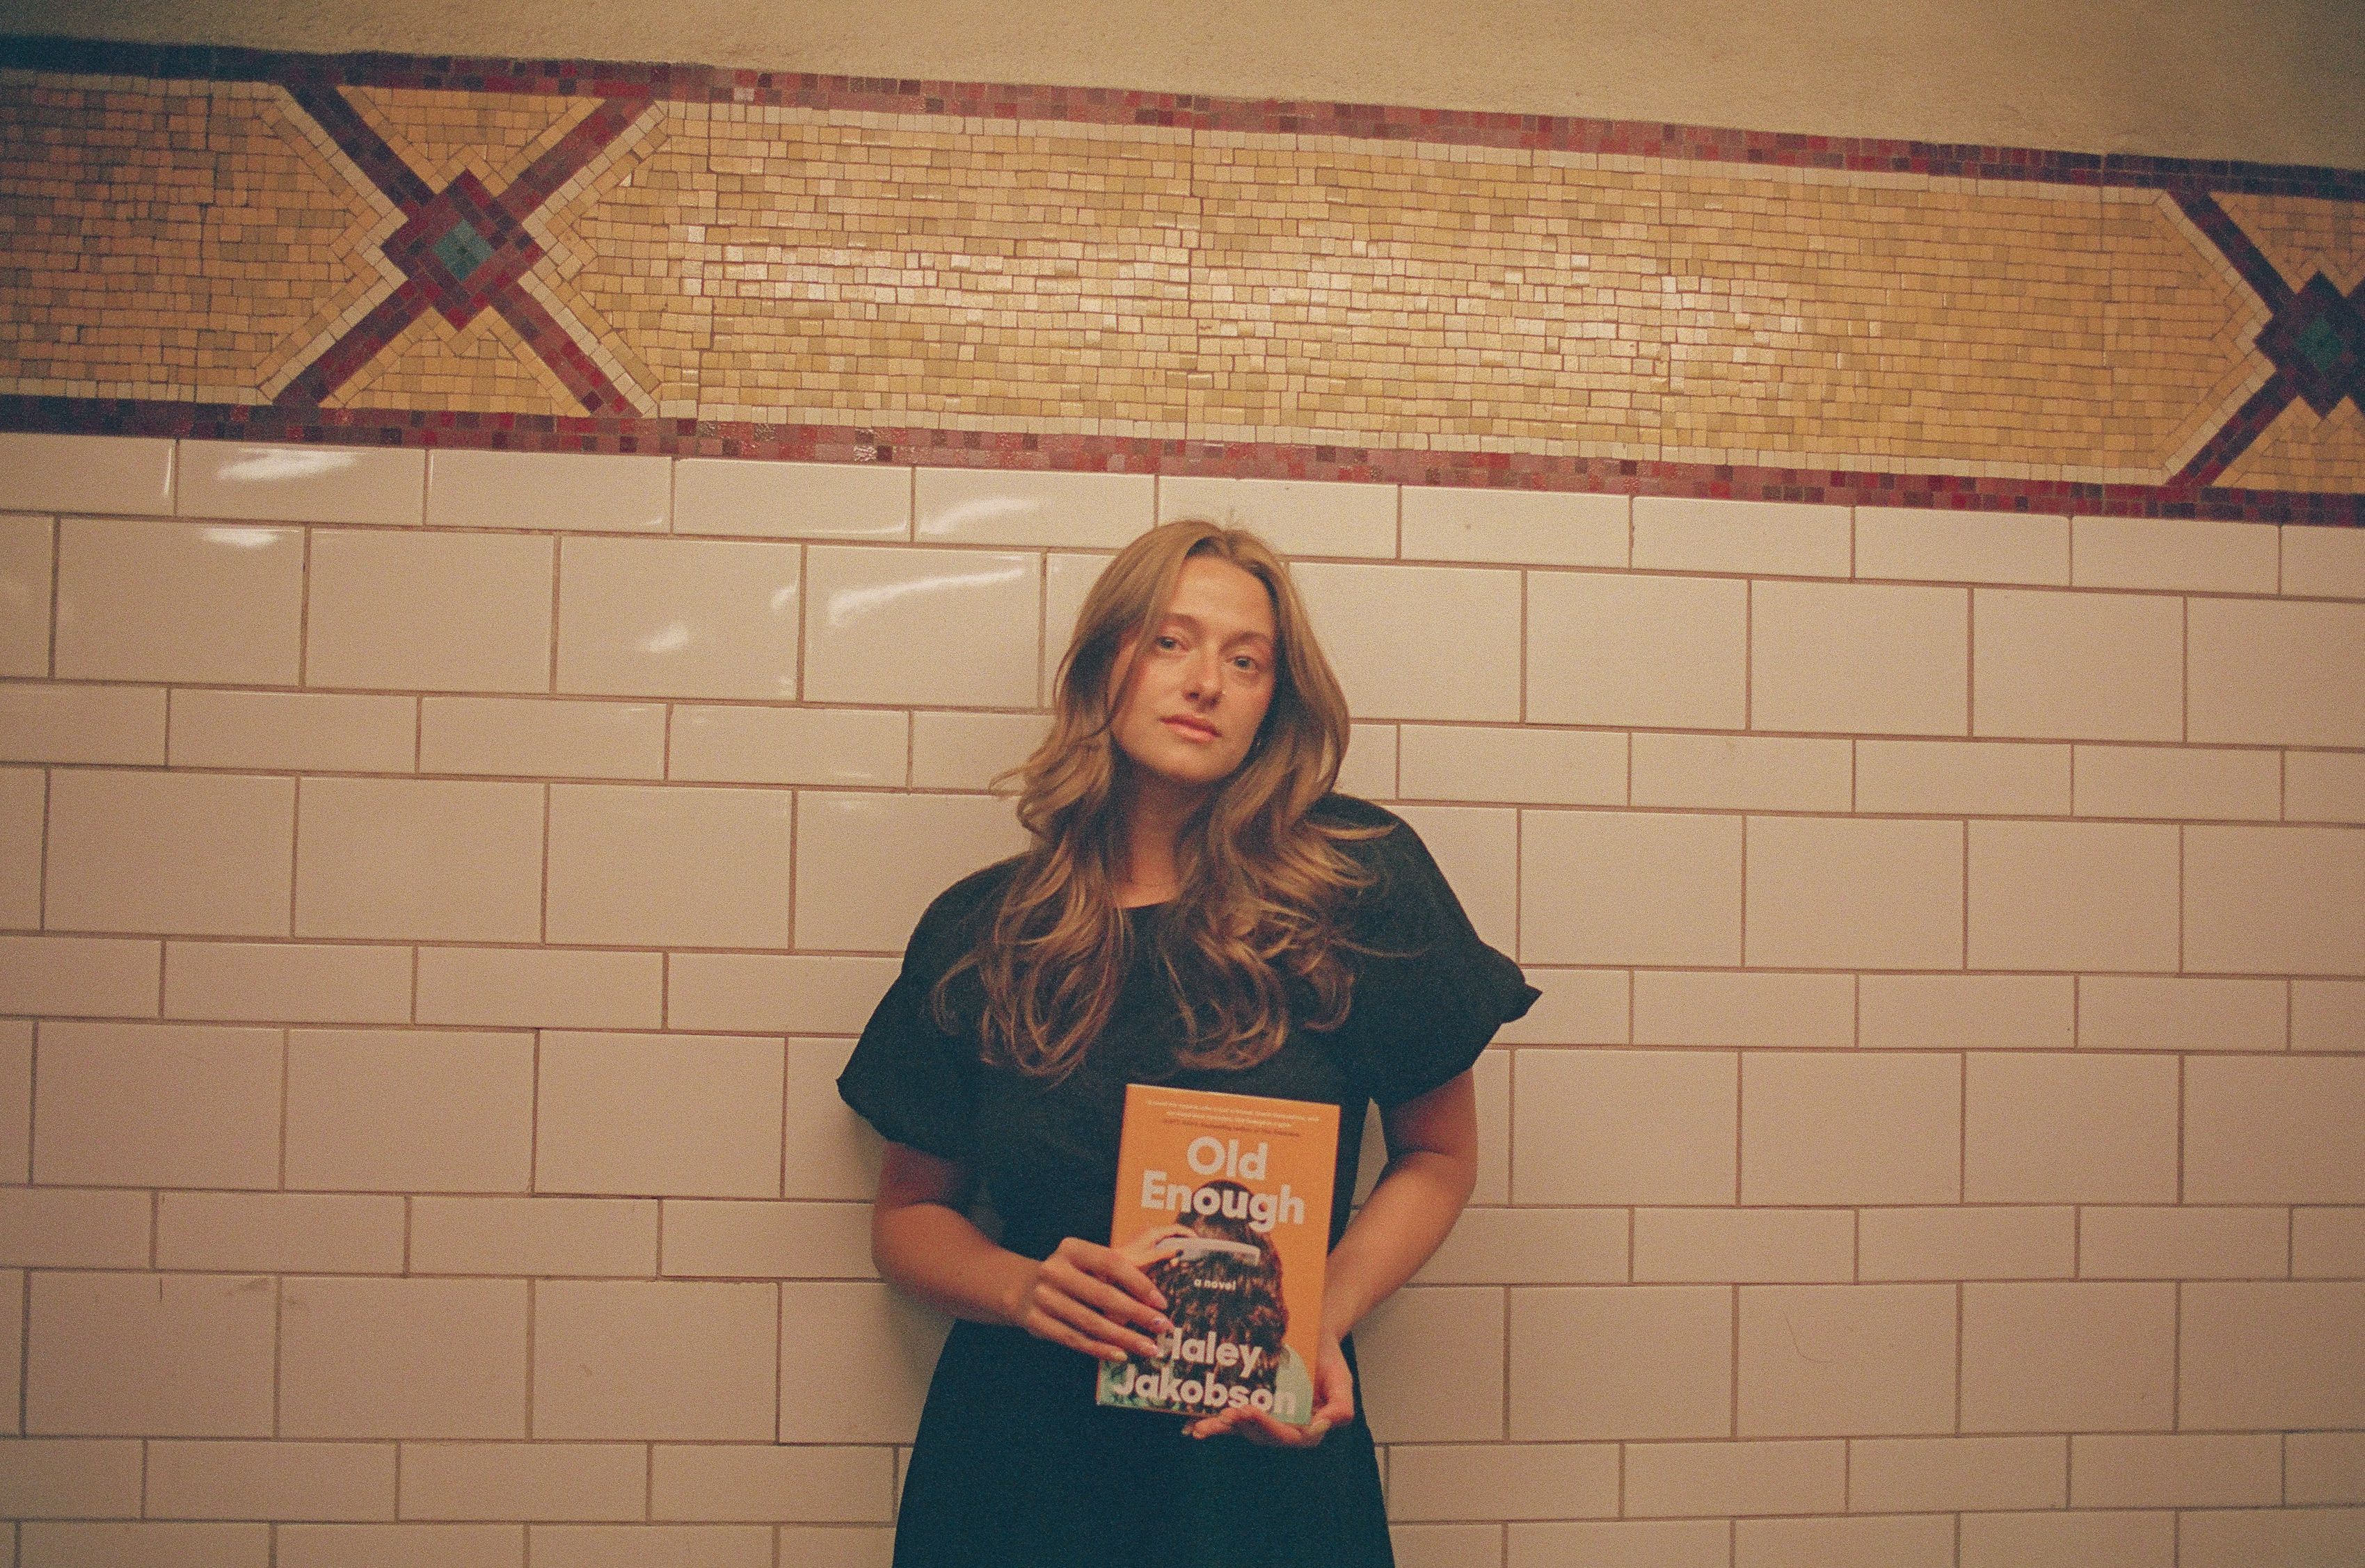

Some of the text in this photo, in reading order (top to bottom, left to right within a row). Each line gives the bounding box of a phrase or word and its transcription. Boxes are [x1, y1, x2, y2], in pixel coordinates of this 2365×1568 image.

[1187, 1137, 1268, 1181] Old
[1141, 1171, 1305, 1233] Enough
[1194, 1279, 1236, 1291] a novel
[1113, 1363, 1296, 1415] Jakobson
